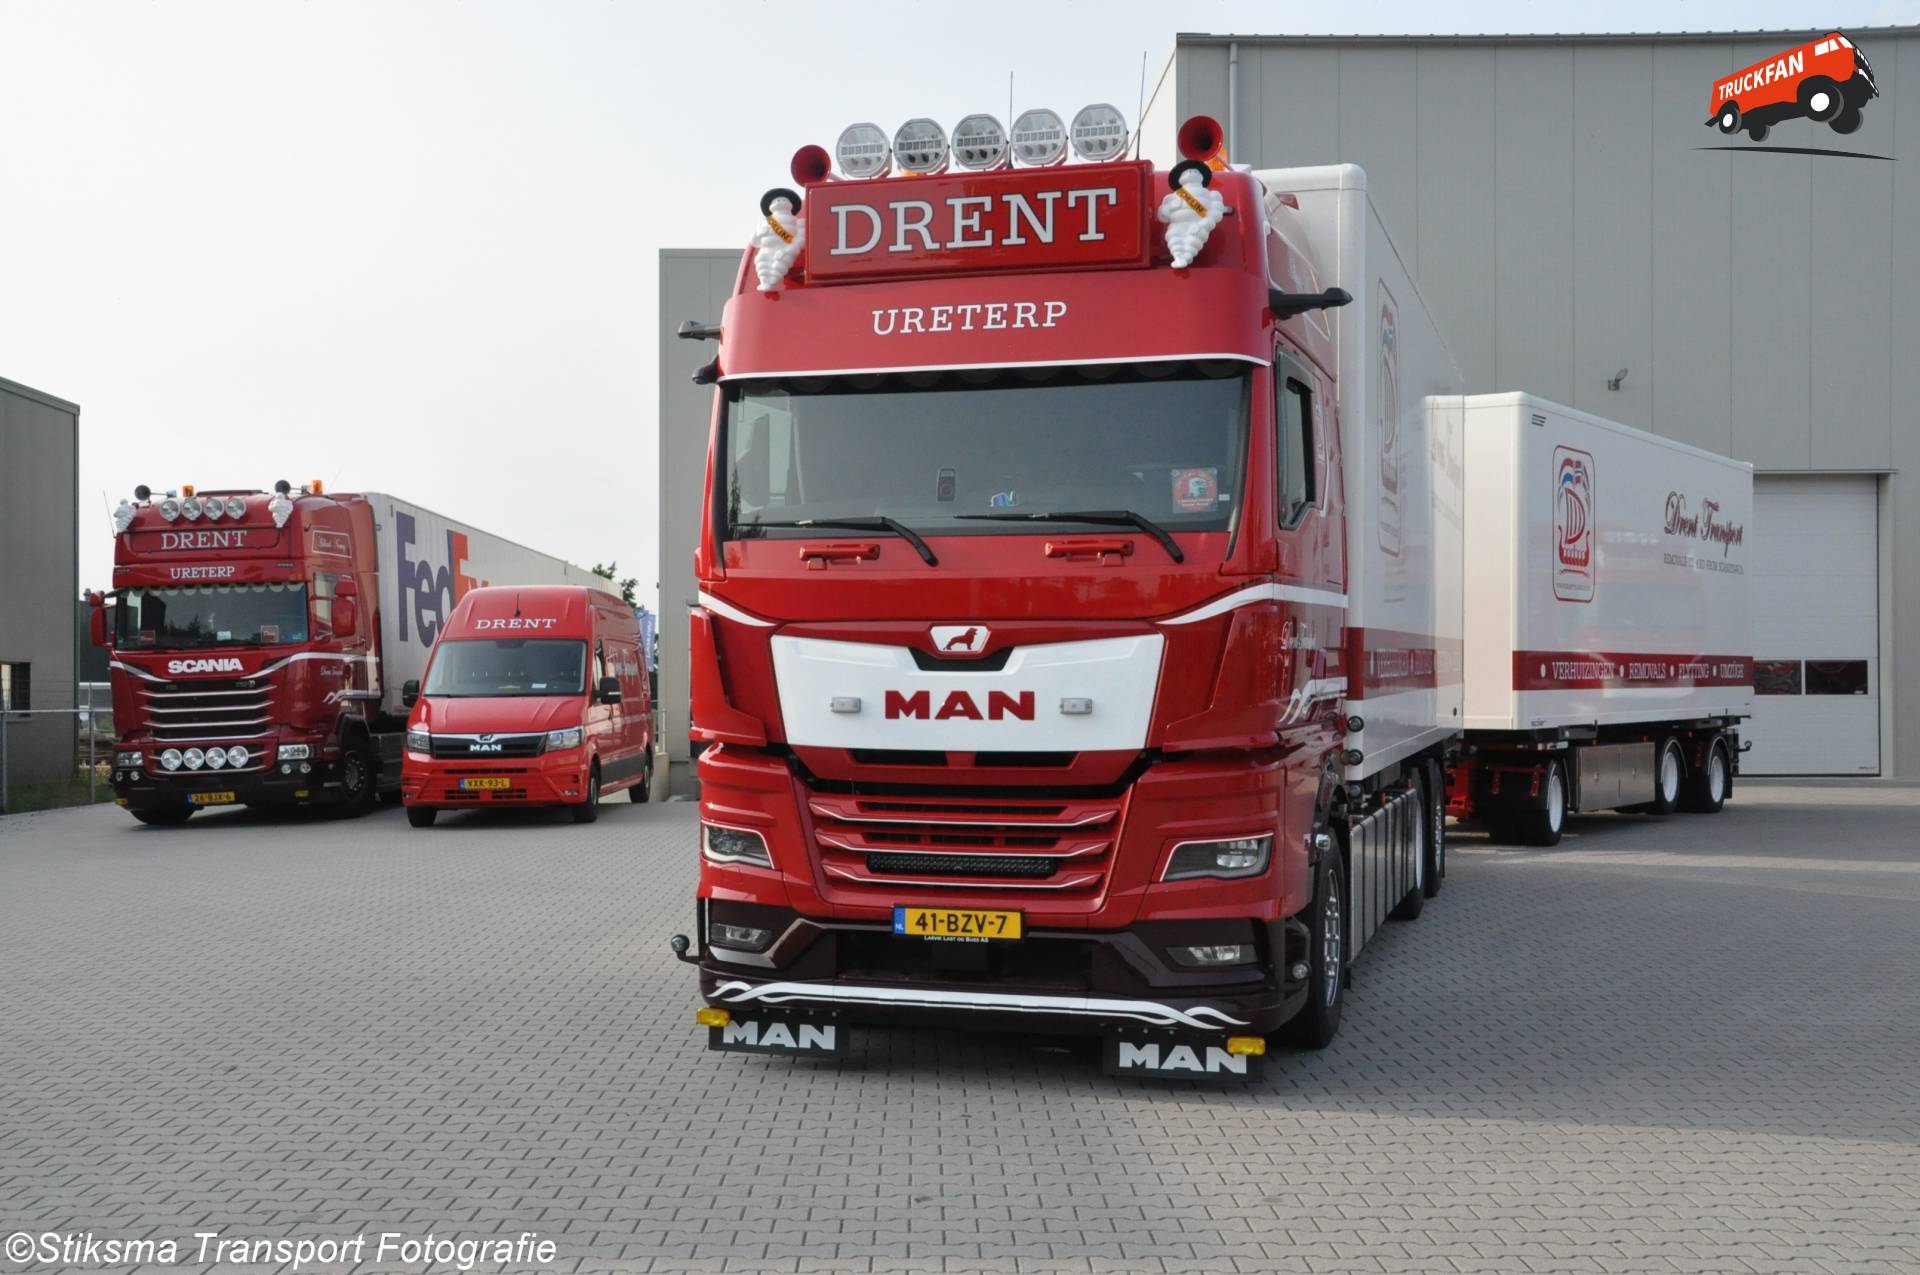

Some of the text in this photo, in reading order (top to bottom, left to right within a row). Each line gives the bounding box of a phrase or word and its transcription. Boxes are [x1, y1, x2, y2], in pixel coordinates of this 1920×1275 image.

[829, 187, 1118, 257] DRENT
[872, 301, 1068, 335] URETERP
[161, 530, 247, 549] DRENT
[170, 566, 235, 579] URETERP
[475, 618, 557, 630] DRENT
[168, 658, 243, 673] SCANIA
[1552, 661, 1615, 680] VERHUIZINGEN
[1629, 663, 1666, 679] REMOVALS
[884, 690, 1035, 721] MAN
[915, 912, 1007, 934] 41-BZV-7
[722, 1020, 836, 1051] MAN
[1119, 1041, 1247, 1074] MAN
